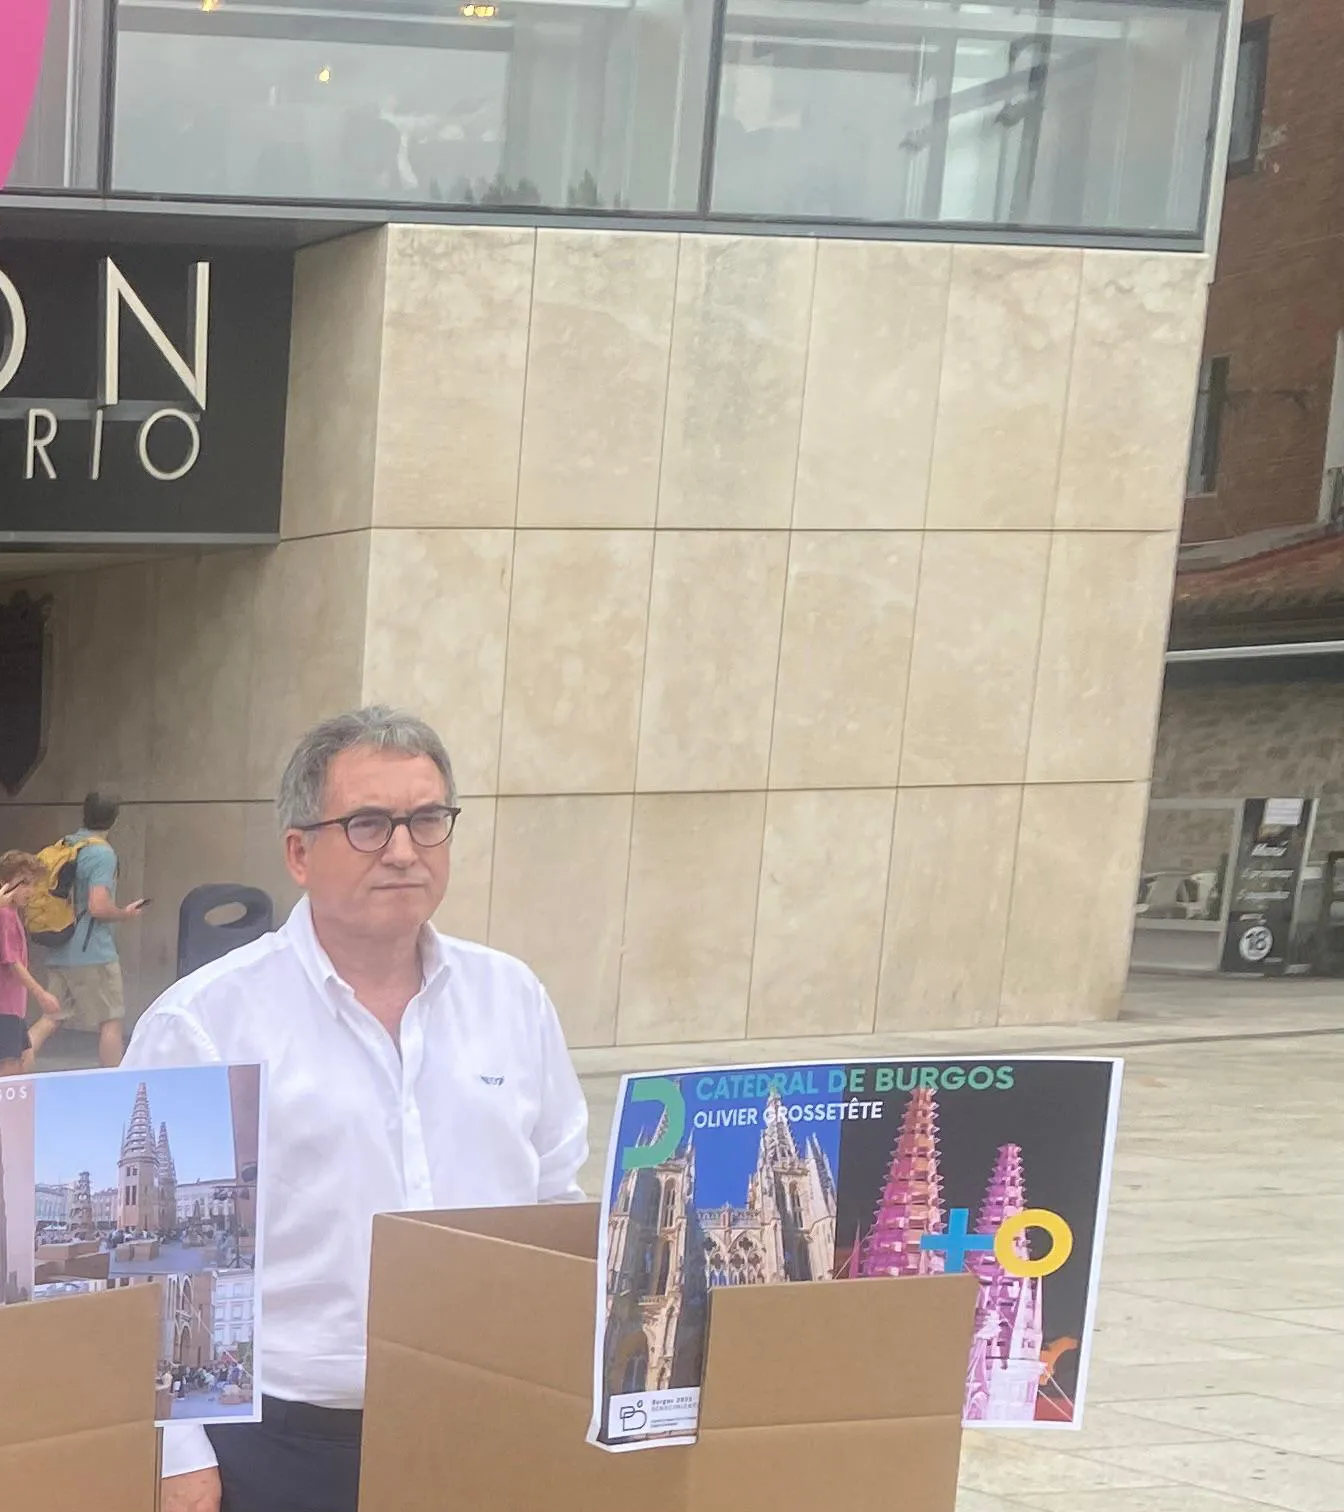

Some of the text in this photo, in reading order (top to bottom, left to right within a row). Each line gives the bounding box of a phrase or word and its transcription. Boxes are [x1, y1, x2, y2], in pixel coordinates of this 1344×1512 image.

[695, 1065, 1015, 1101] CATEDRAL DE BURGOS
[693, 1097, 884, 1129] OLIVIER GROSSETÊTE
